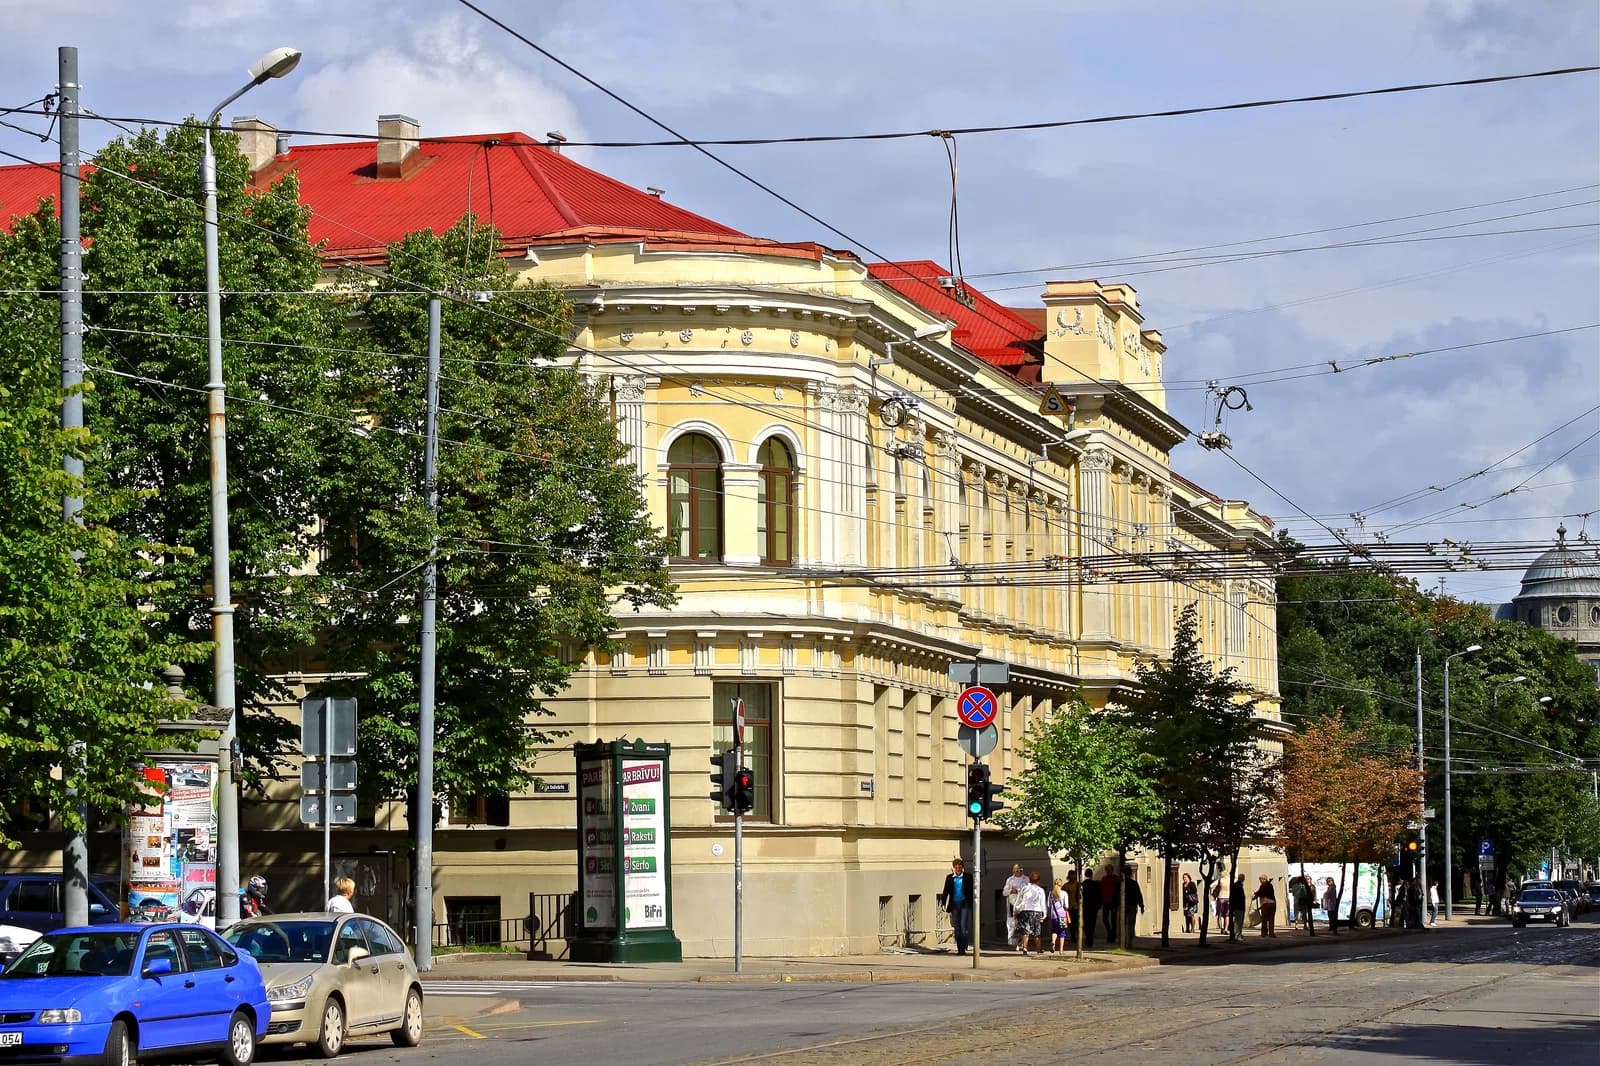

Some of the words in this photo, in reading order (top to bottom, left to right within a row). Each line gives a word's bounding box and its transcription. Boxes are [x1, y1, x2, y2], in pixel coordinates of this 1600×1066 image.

[1047, 397, 1059, 411] S
[632, 767, 660, 780] BRĪVU!
[631, 801, 650, 812] Zvani
[631, 831, 653, 841] Raksti
[1481, 842, 1490, 853] P
[644, 904, 663, 919] BiFri
[2, 1034, 20, 1044] 054
